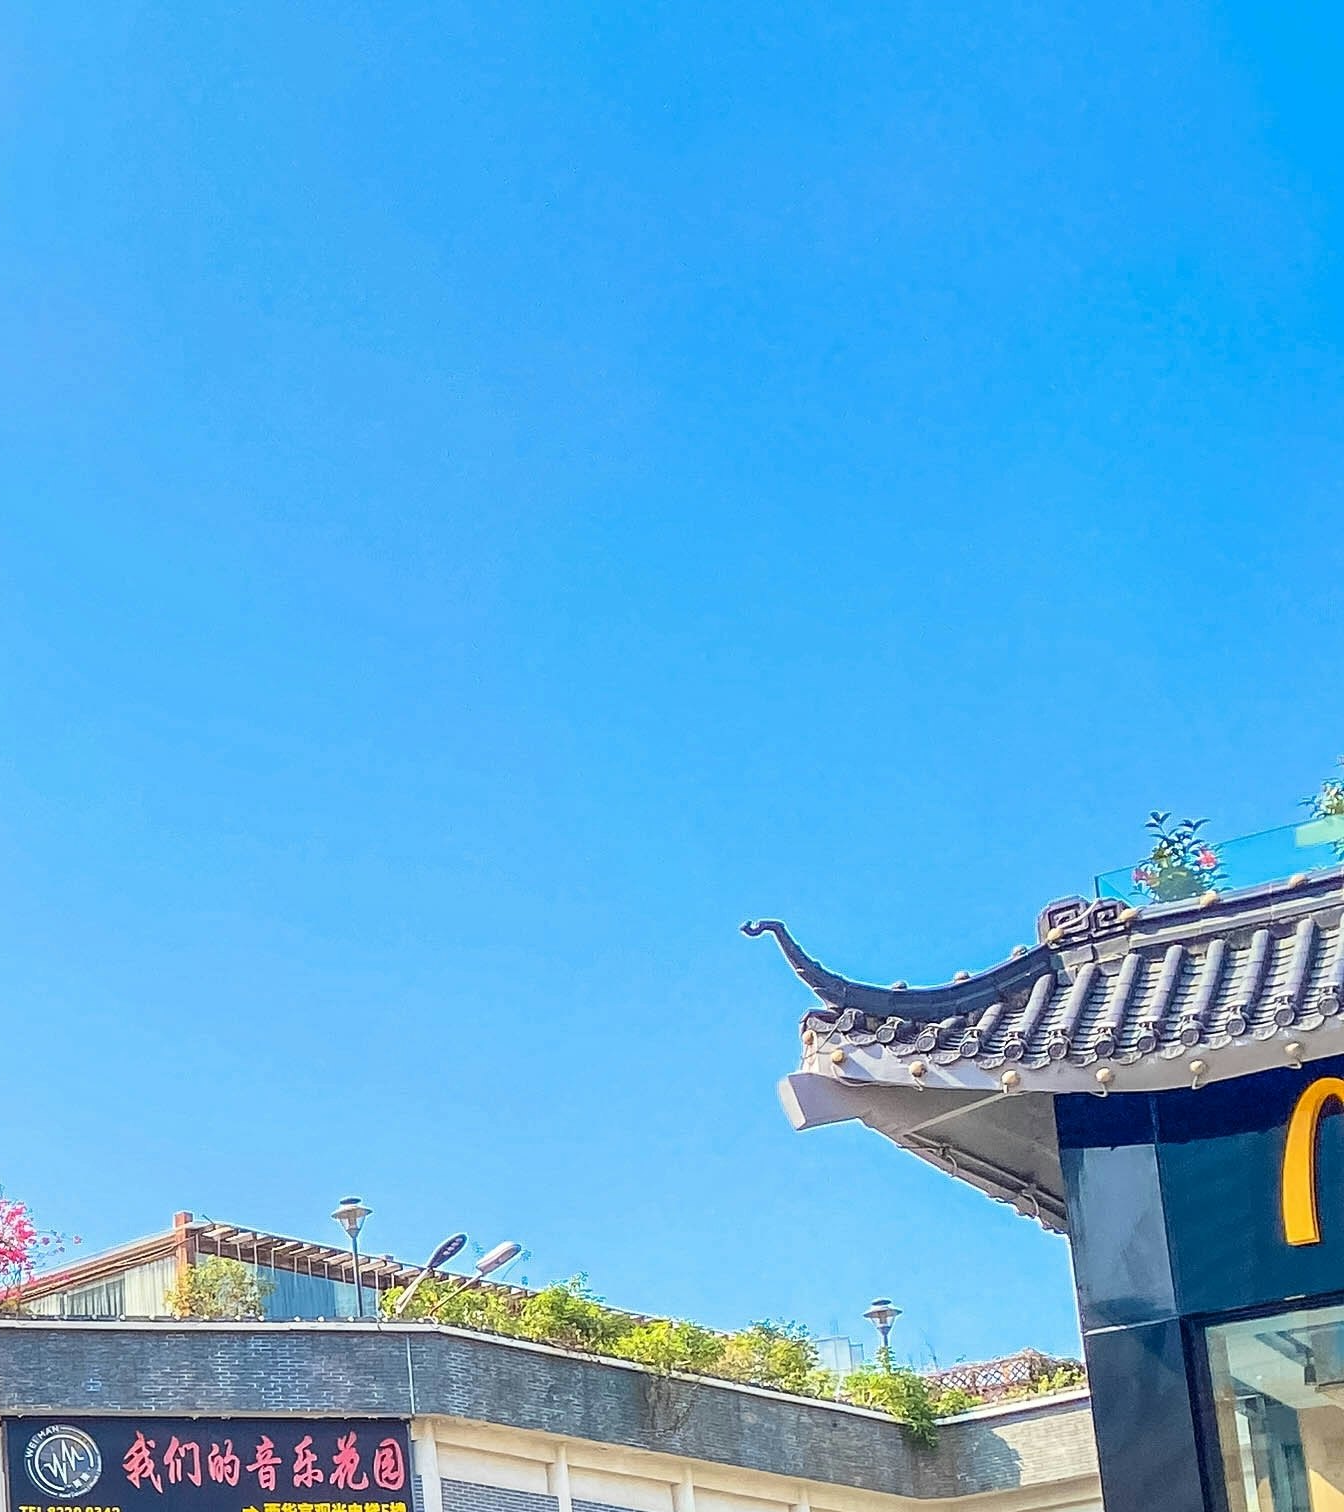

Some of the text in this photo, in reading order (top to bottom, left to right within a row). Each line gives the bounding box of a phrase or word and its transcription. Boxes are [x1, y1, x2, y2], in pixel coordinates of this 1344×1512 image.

[122, 1430, 408, 1492] 我们的音乐花园
